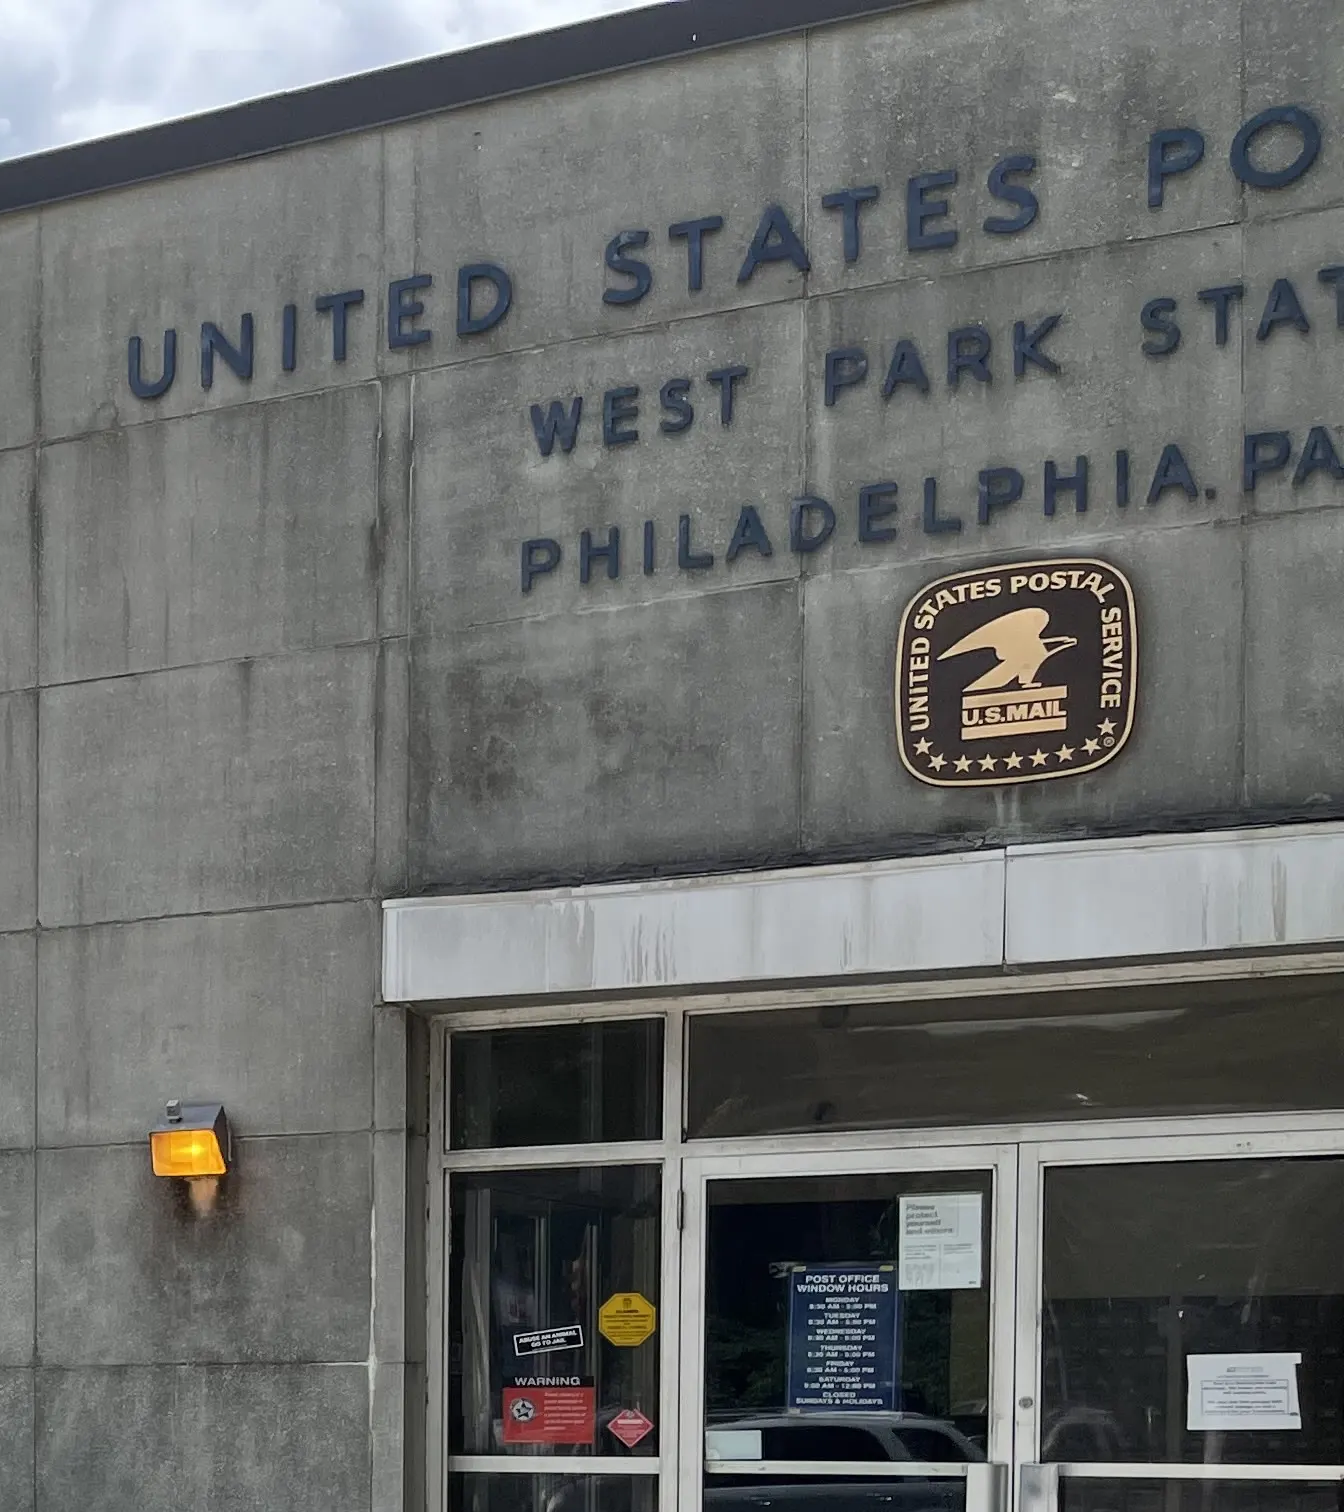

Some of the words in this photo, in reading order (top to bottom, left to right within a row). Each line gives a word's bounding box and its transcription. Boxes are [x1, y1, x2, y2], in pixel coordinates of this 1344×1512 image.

[127, 263, 513, 400] UNITED
[602, 155, 1040, 306] STATES
[1147, 106, 1322, 212] PO
[529, 365, 748, 458] WEST
[823, 313, 1064, 407] PARK
[1243, 426, 1344, 492] PA
[914, 579, 1002, 630] STATES
[1010, 570, 1115, 604] POSTAL
[1099, 606, 1123, 709] SERVICE
[909, 636, 931, 732] UNITED
[796, 1284, 845, 1293] WINDOW
[848, 1284, 888, 1292] HOURS
[805, 1275, 836, 1283] POST
[838, 1274, 880, 1283] OFFICE
[519, 1335, 540, 1344] ABUSE
[552, 1330, 578, 1338] ANIMAL
[514, 1376, 581, 1386] WARNING
